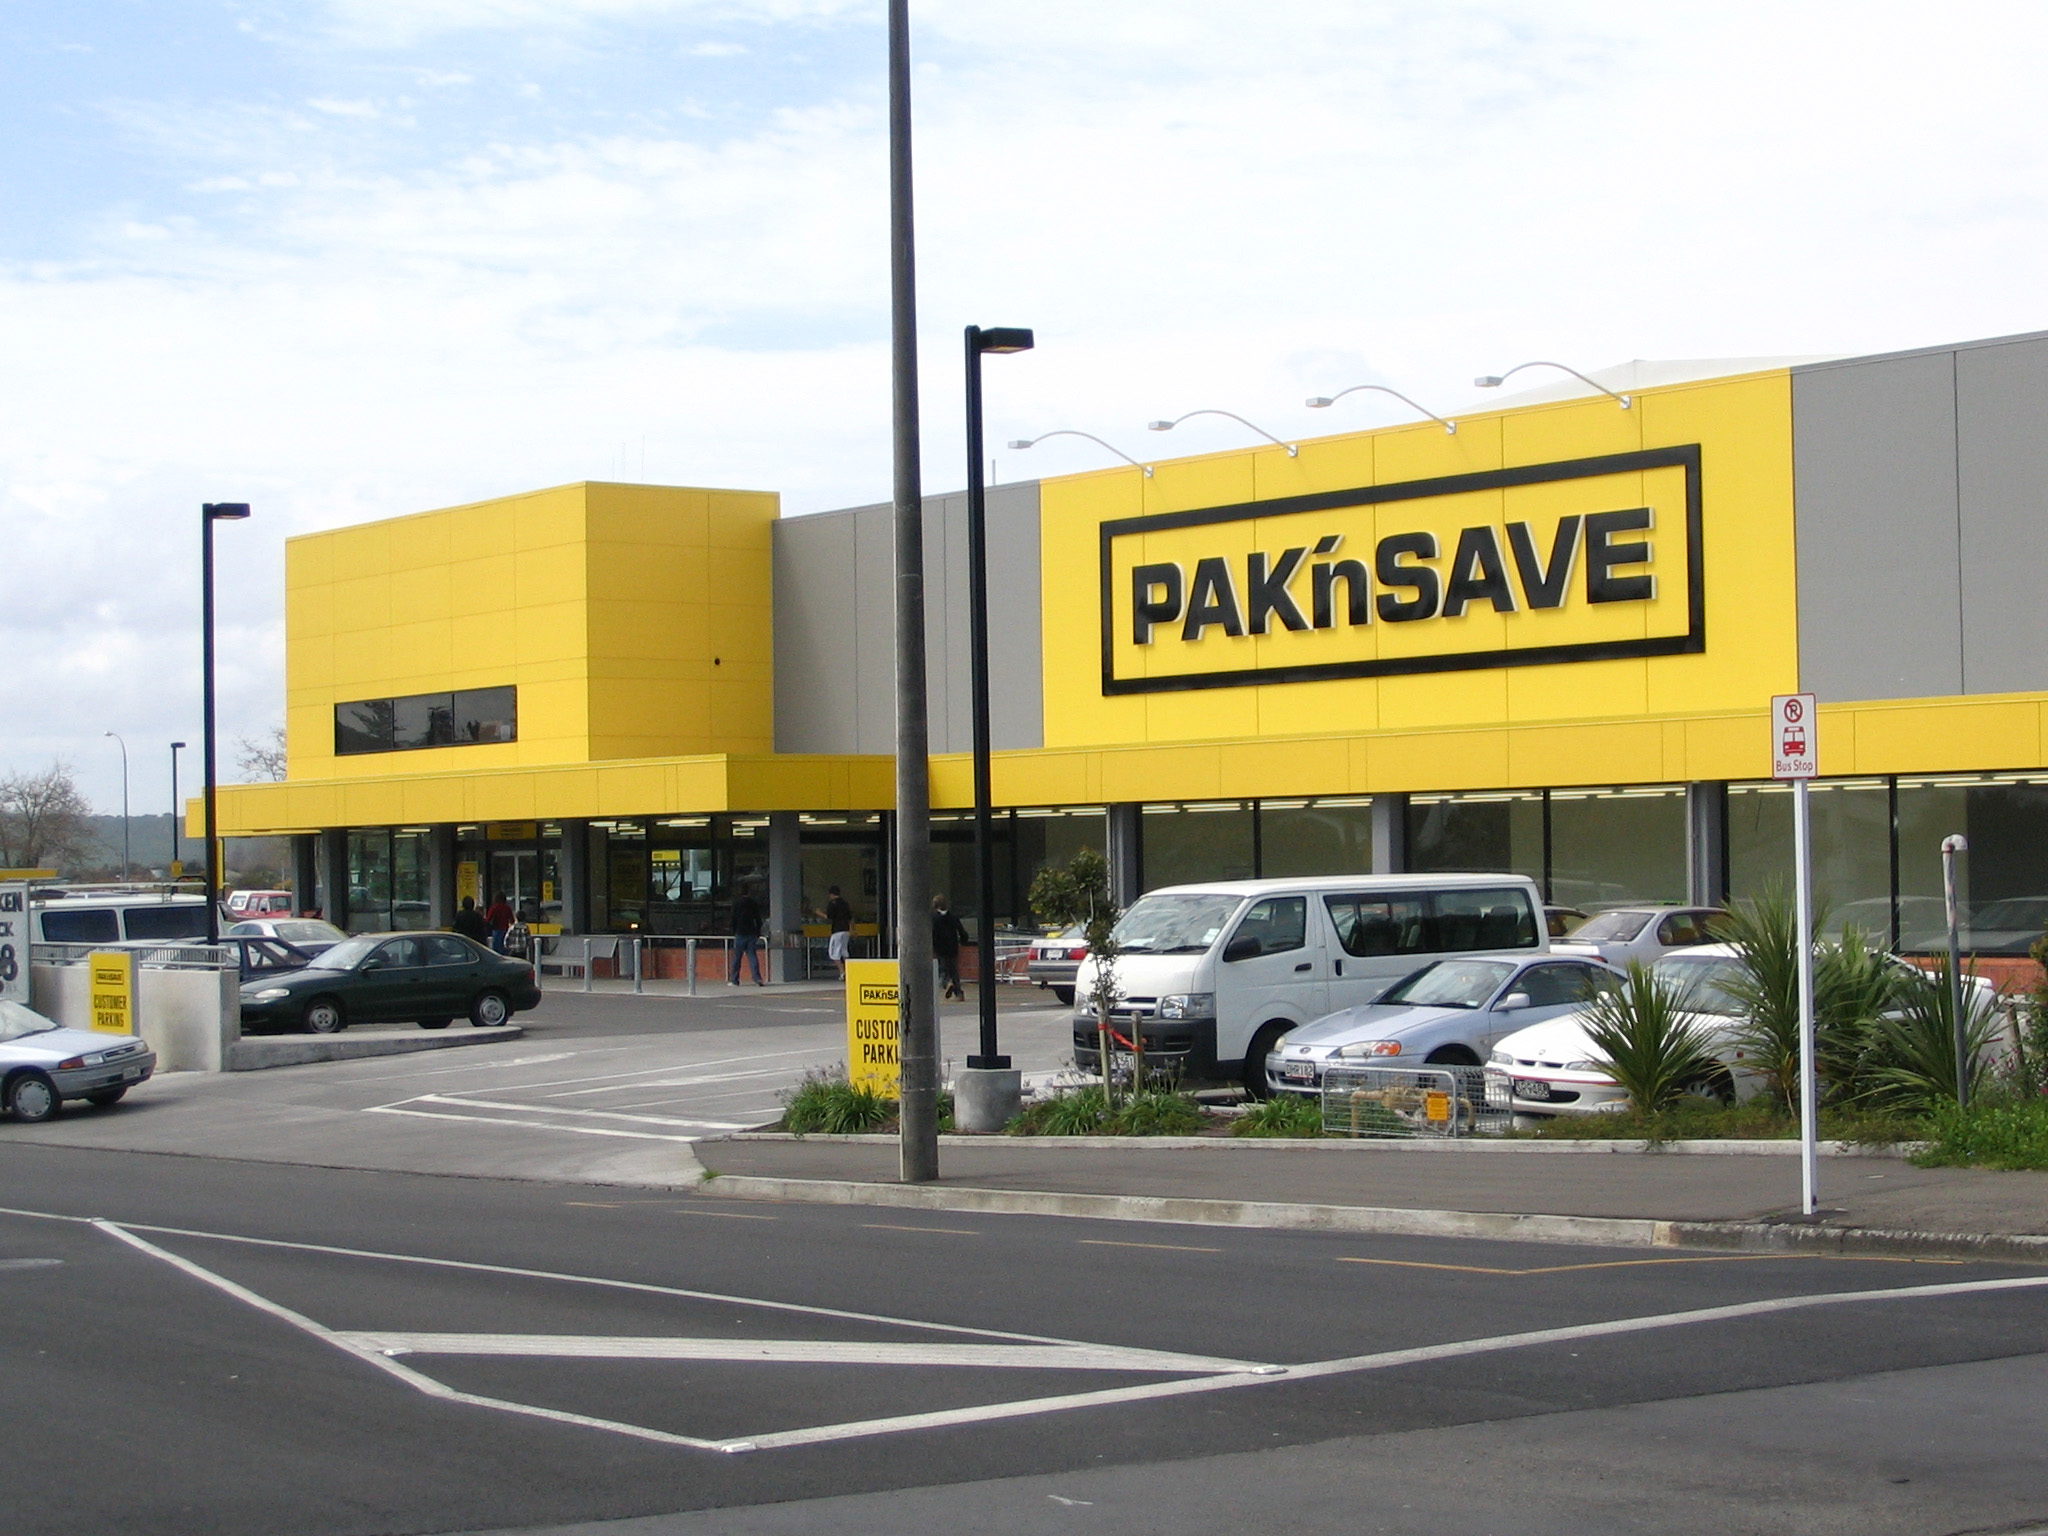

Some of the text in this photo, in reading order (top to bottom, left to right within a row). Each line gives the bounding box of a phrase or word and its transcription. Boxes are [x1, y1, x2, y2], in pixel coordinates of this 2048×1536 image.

[1776, 759, 1813, 773] Bus Stop
[94, 993, 127, 1009] CUSTOMER
[863, 988, 899, 1000] PAK'nSA
[97, 1011, 124, 1027] PARKING
[856, 1019, 899, 1040] CUSTO
[863, 1044, 899, 1065] PARKI
